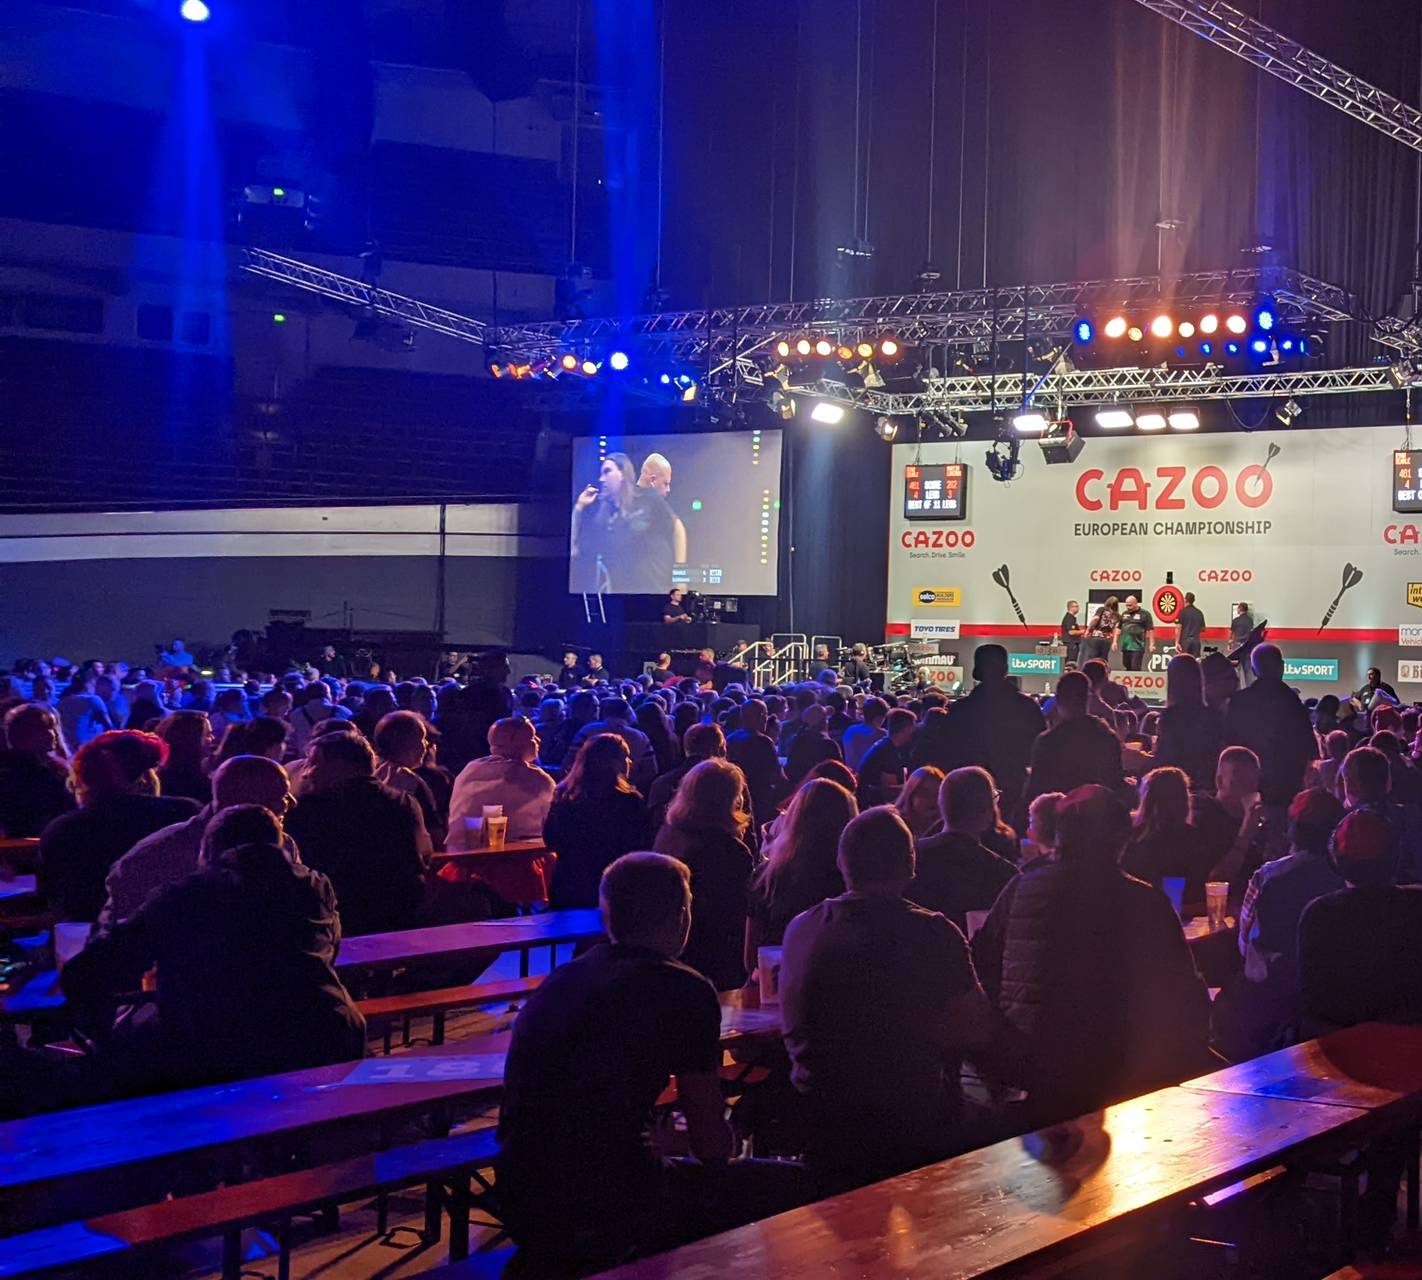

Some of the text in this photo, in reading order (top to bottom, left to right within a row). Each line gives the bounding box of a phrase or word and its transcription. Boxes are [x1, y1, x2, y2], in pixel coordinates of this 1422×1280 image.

[1075, 464, 1273, 511] CAZOO
[1404, 479, 1410, 489] 4
[1398, 490, 1416, 500] BEST
[1074, 520, 1272, 536] EUROPEAN CHAMPIONSHIP
[901, 530, 975, 548] CAZOO
[1090, 570, 1142, 582] CAZOO
[1198, 569, 1253, 582] CAZOO
[1151, 654, 1173, 670] PD
[930, 671, 956, 682] ZOO
